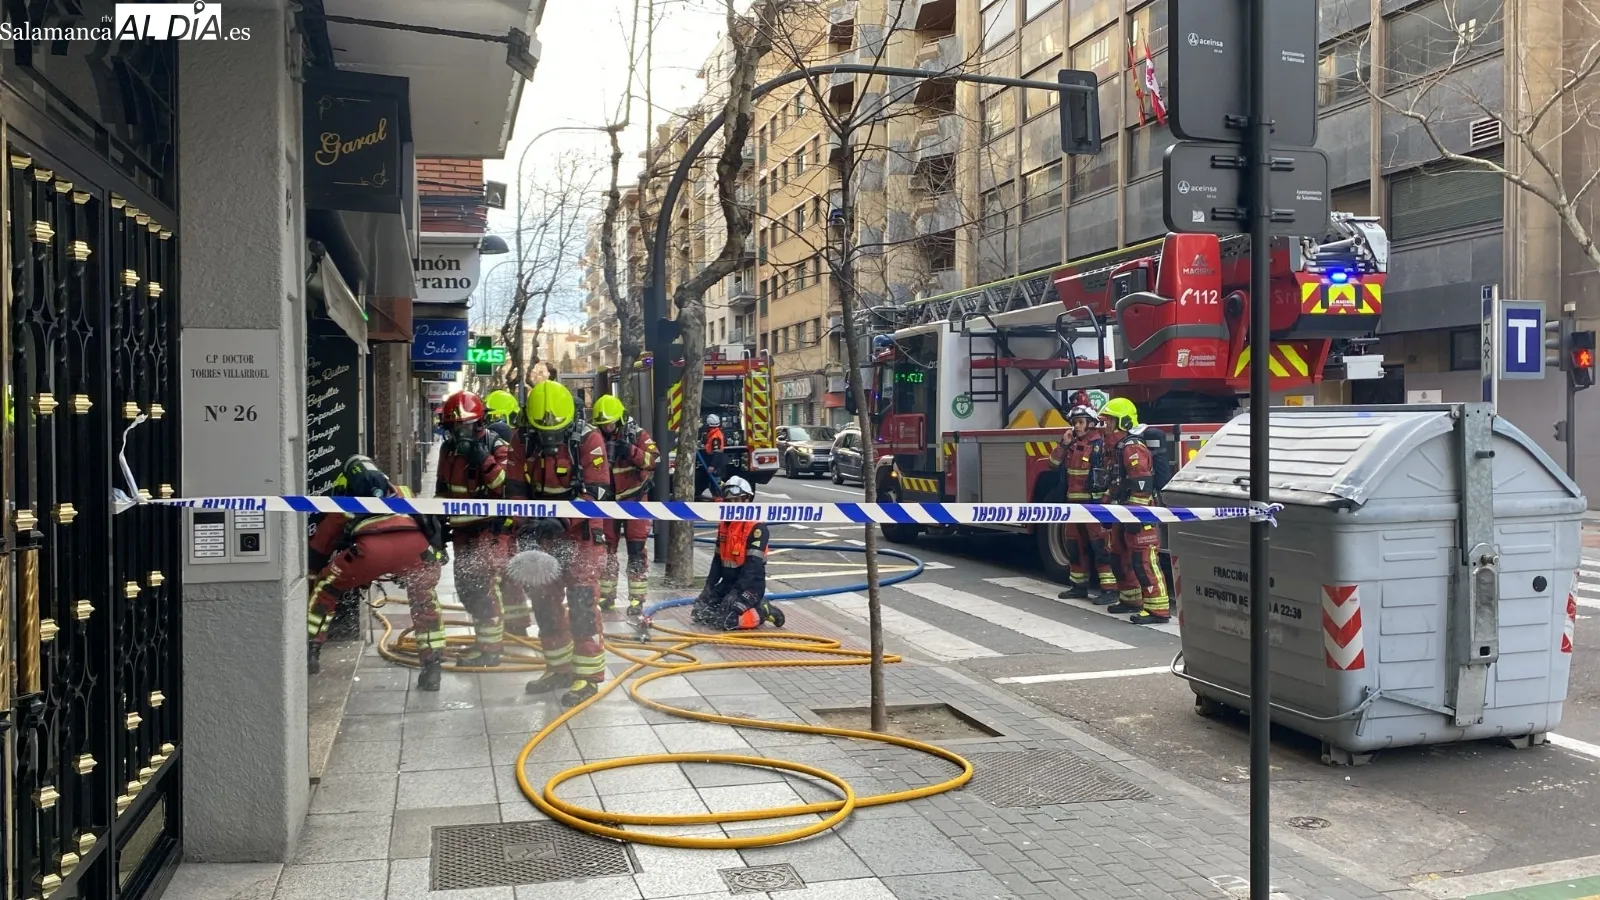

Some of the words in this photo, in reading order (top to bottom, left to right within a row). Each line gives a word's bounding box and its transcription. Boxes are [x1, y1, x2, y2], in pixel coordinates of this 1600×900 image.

[1199, 37, 1223, 48] aceinsa
[315, 117, 387, 165] Garal
[1191, 184, 1217, 193] aceinsa
[1193, 289, 1218, 305] 112
[1484, 288, 1490, 297] T
[415, 324, 467, 339] Pescados
[423, 342, 457, 356] Sebas
[1508, 318, 1537, 364] T
[222, 354, 254, 364] DOCTOR
[468, 349, 504, 362] 17:15
[191, 368, 221, 379] TORRES
[223, 368, 270, 379] VILLARROEL
[233, 404, 258, 422] 26
[719, 504, 761, 521] LOCAL
[768, 505, 823, 522] POLICIA
[972, 506, 1012, 522] LOCAL
[1017, 506, 1071, 522] POLICIA
[1273, 602, 1280, 614] A
[1280, 604, 1302, 620] 22:30
